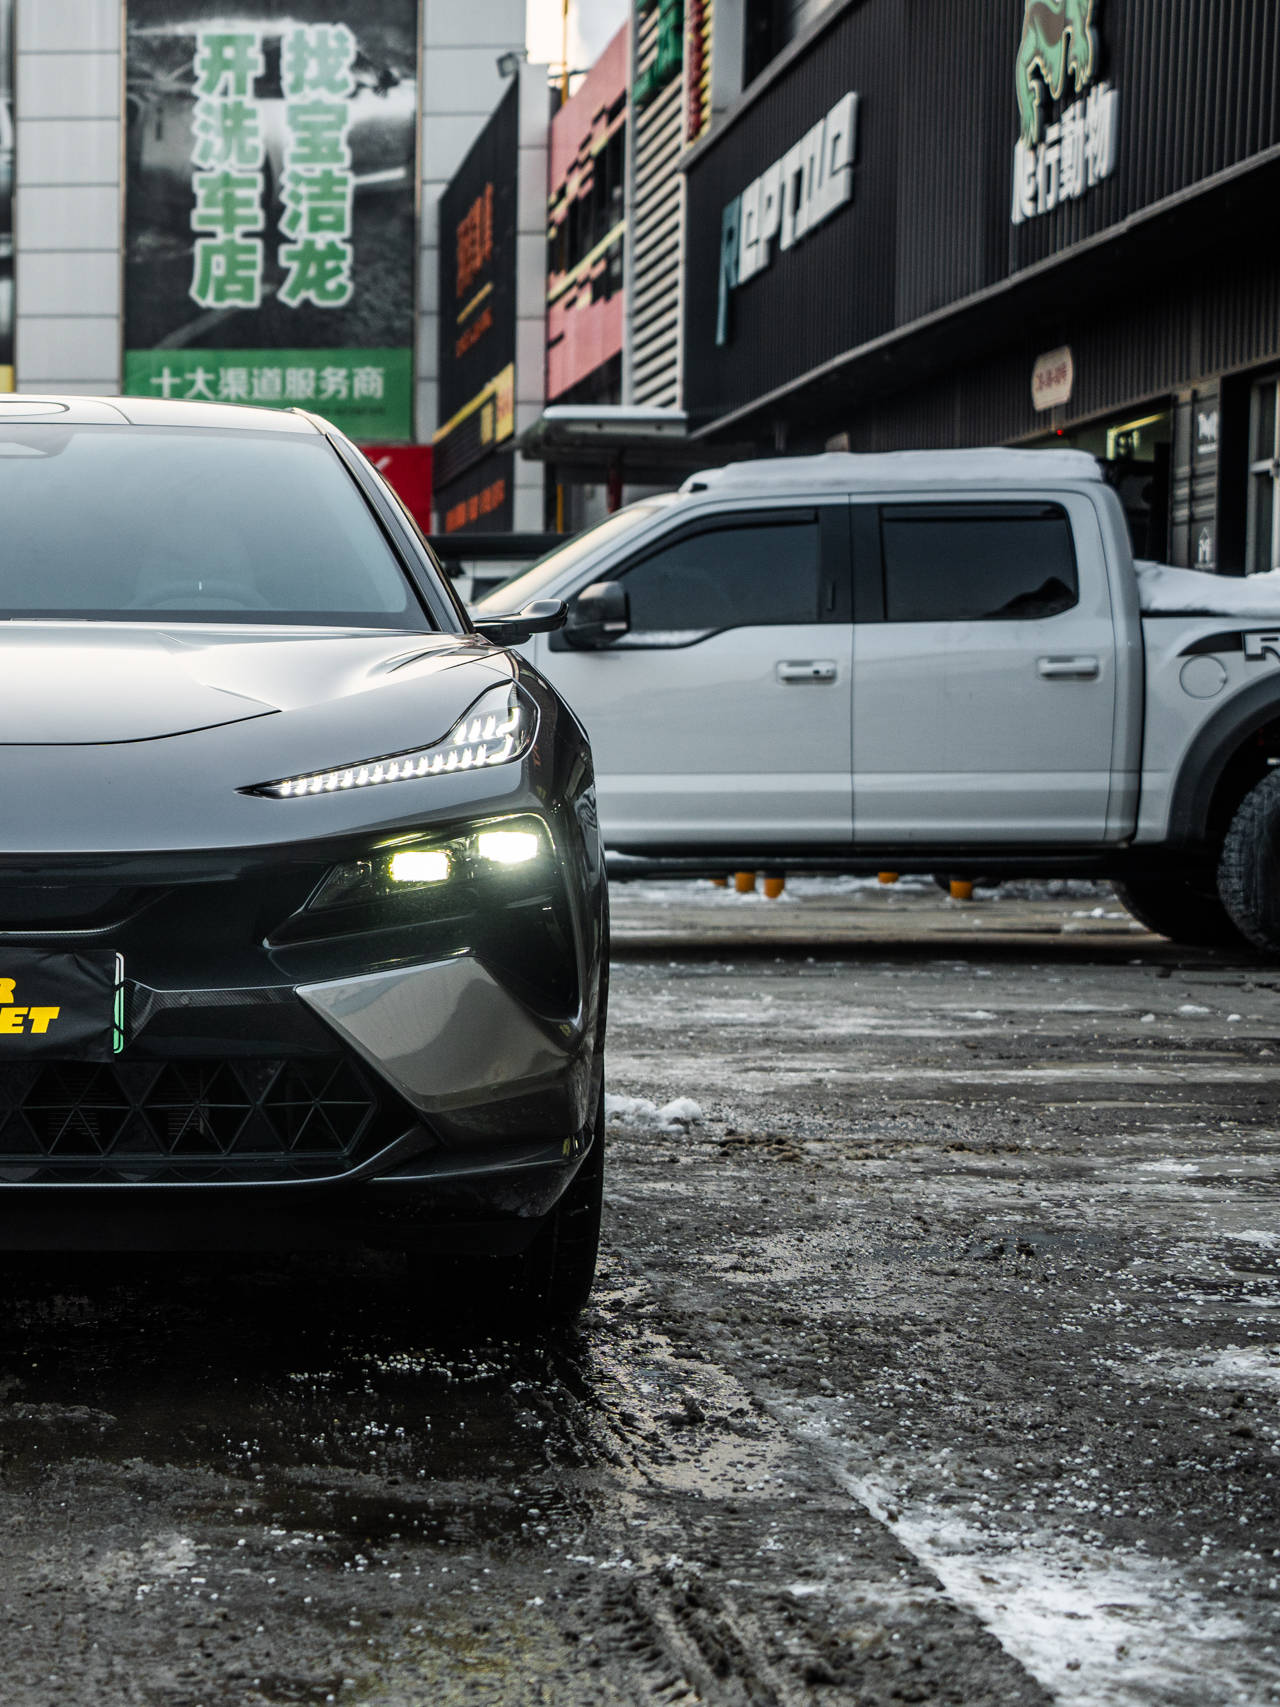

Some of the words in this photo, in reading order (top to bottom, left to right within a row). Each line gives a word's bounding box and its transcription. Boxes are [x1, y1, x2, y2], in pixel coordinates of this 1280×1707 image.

[191, 28, 265, 309] 开洗车店
[278, 22, 357, 308] 找宝洁龙
[149, 365, 385, 400] 十大渠道服务商
